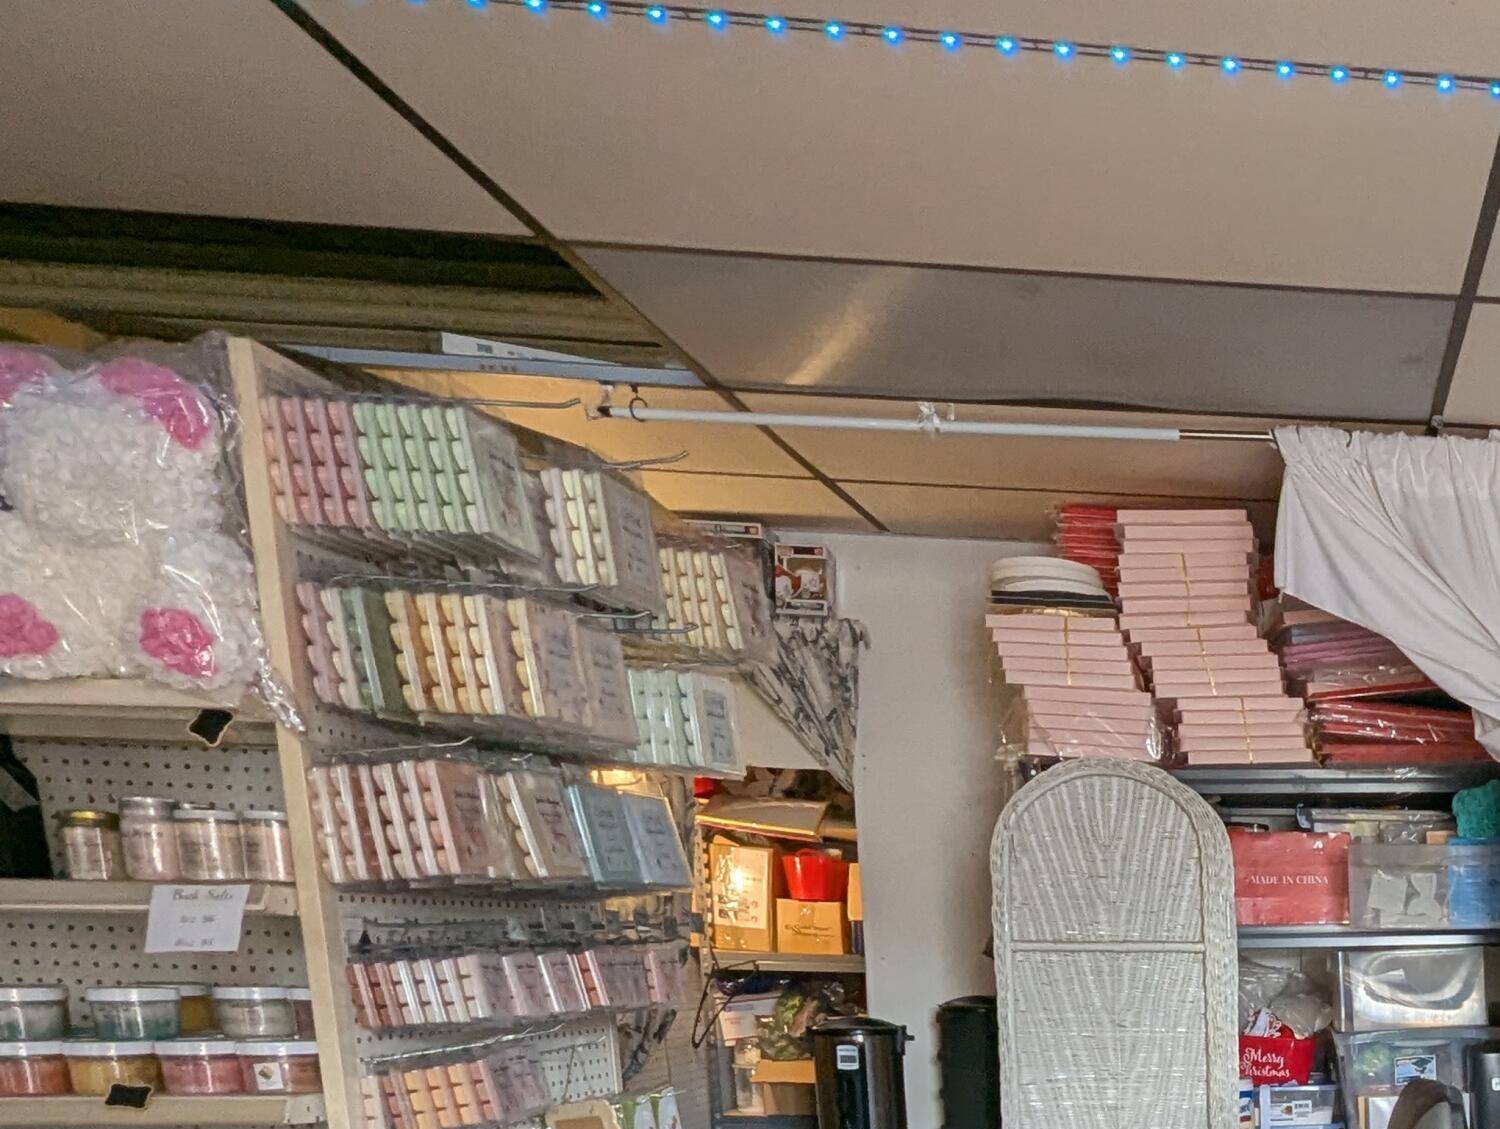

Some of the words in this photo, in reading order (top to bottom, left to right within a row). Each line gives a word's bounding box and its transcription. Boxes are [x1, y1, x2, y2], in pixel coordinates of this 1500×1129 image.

[1250, 875, 1279, 885] MADE
[1282, 875, 1294, 885] IN
[1296, 875, 1329, 885] CHINA
[1242, 1047, 1285, 1068] Merry
